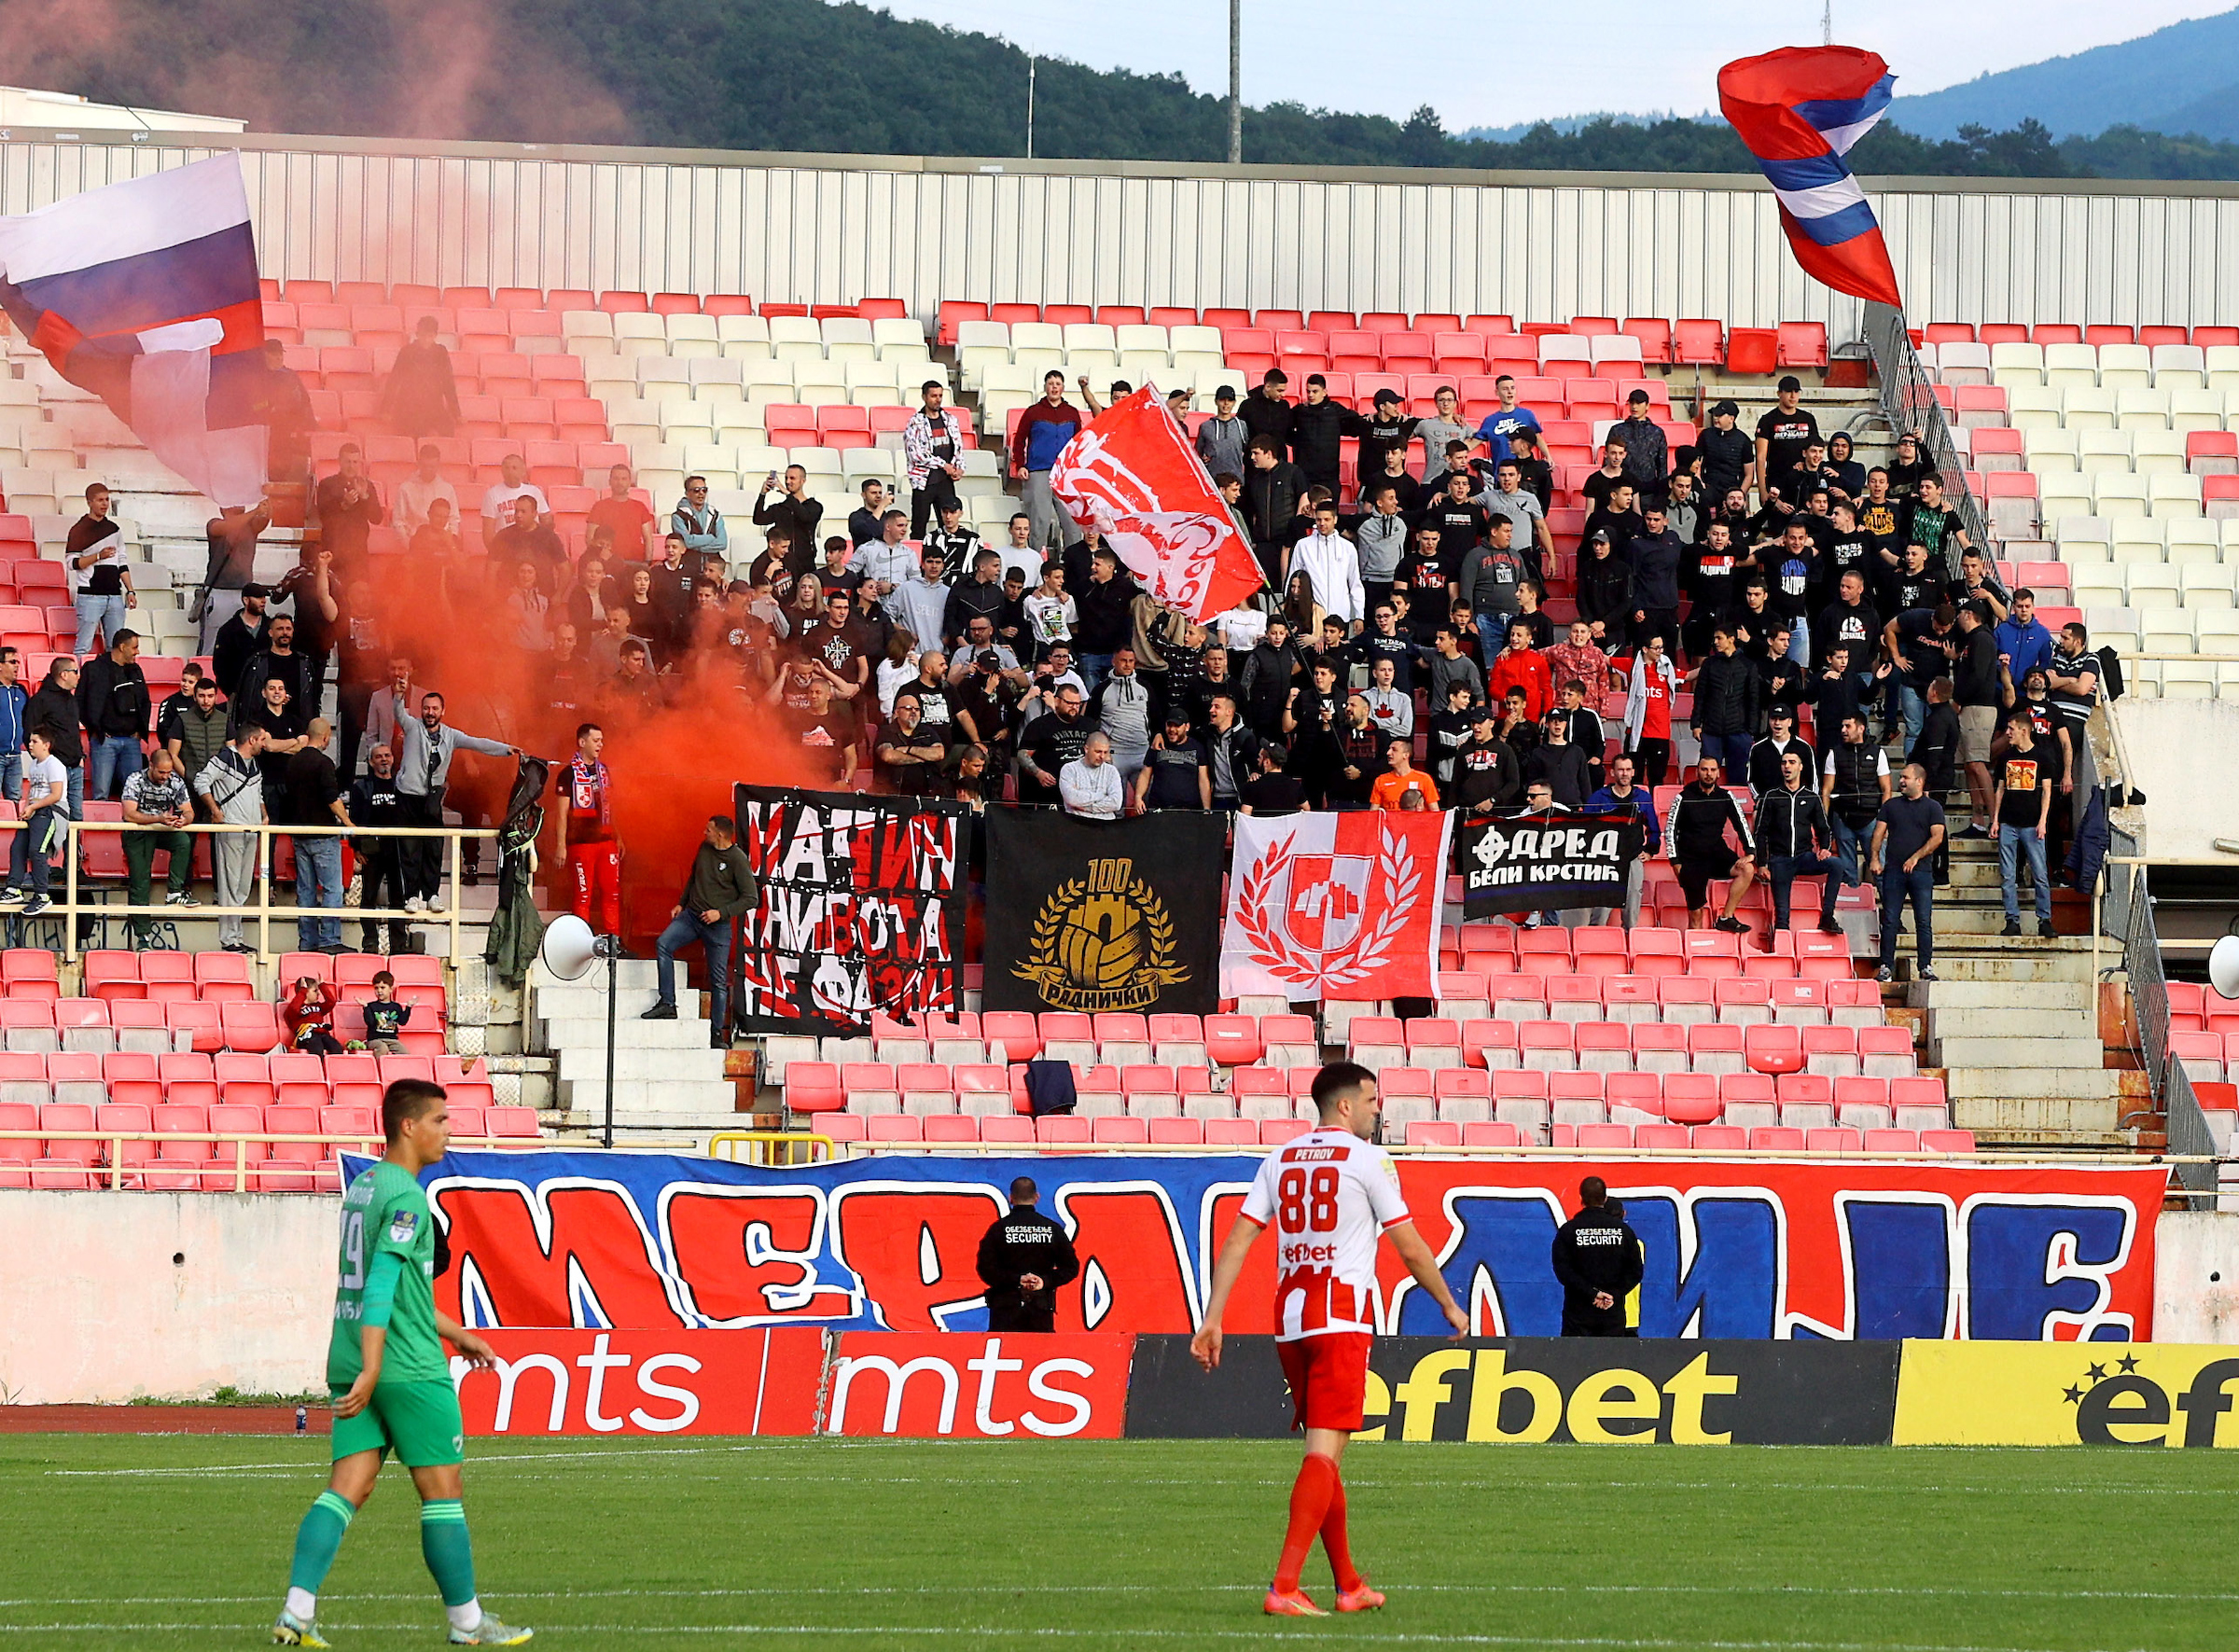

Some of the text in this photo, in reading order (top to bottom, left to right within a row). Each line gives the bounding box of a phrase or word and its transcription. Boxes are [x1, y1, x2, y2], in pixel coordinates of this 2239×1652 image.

[1088, 858, 1133, 893] 100
[1469, 863, 1620, 889] БЕЛИ КРСТИЋ
[1046, 985, 1150, 1008] РАДНИЧКИ
[1294, 1147, 1335, 1160] PETROV
[1279, 1166, 1340, 1233] 88
[1006, 1233, 1052, 1243] SECURITY
[1576, 1236, 1622, 1246] SECURITY
[1284, 1242, 1337, 1263] efbet
[451, 1334, 702, 1433] mts
[827, 1338, 1095, 1437] mts
